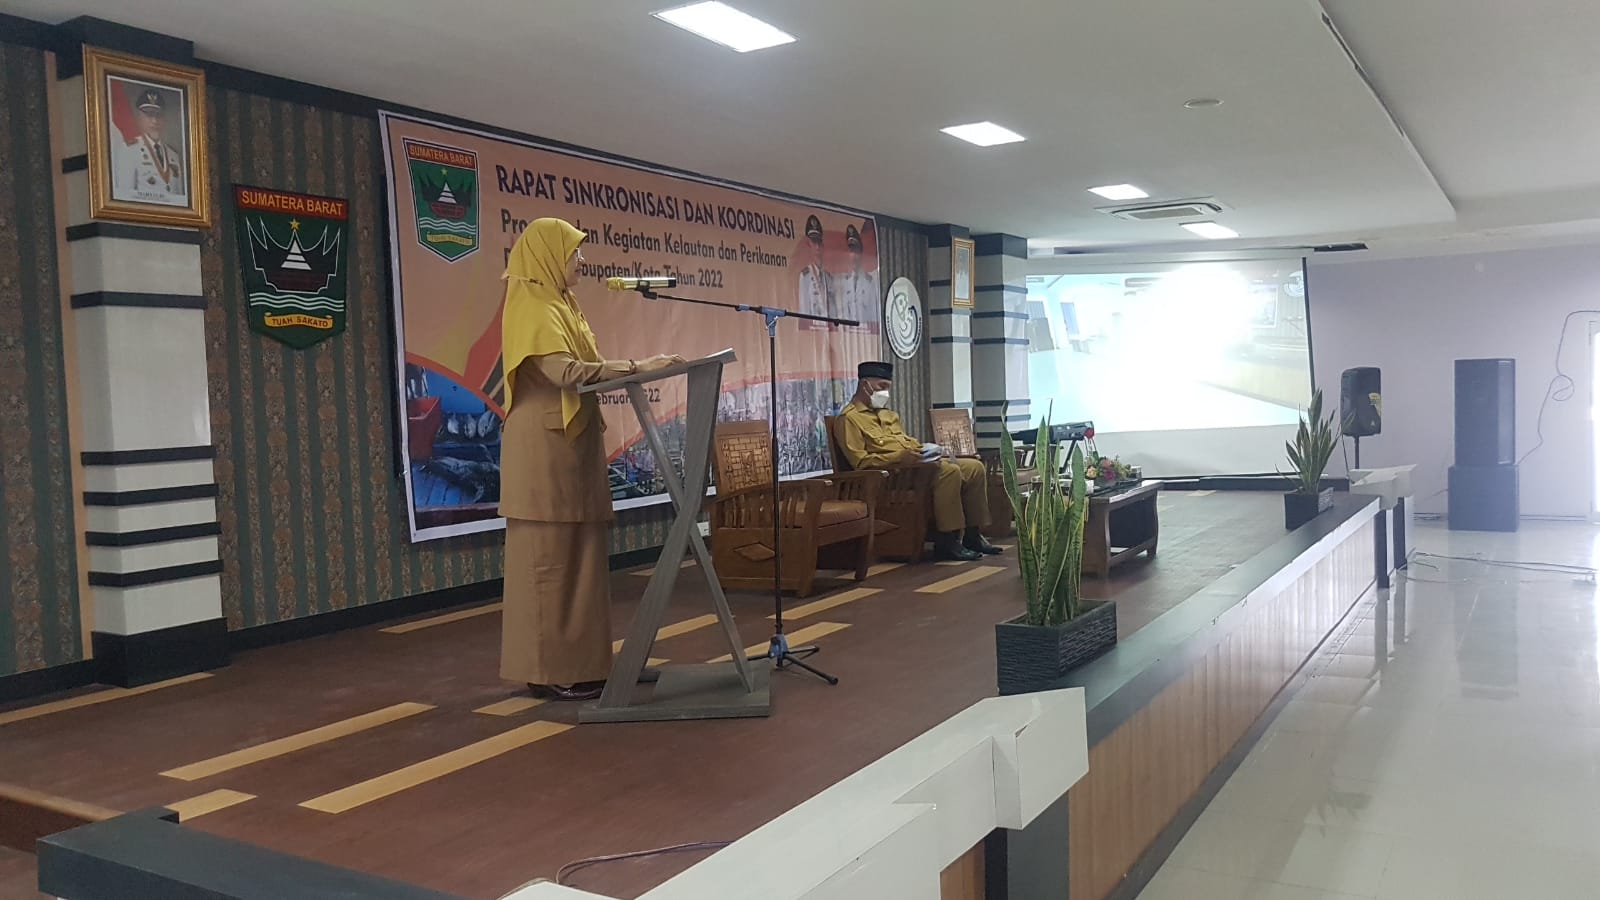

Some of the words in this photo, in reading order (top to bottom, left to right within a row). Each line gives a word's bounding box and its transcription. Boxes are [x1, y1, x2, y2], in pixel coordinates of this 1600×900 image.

[409, 144, 449, 162] SUMATERA
[449, 152, 474, 168] BARAT
[242, 190, 304, 211] SUMATERA
[306, 199, 343, 215] BARAT
[496, 165, 556, 200] RAPAT
[562, 177, 680, 221] SINKRONISASI
[684, 200, 714, 225] DAN
[717, 205, 795, 239] KOORDINASI
[603, 223, 661, 253] Kegiatan
[664, 232, 715, 258] Kelautan
[718, 240, 737, 262] dan
[740, 243, 787, 267] Perikanan
[582, 260, 661, 283] bupaten/Kota
[698, 269, 723, 288] 2022
[272, 317, 293, 326] TUAH
[296, 316, 328, 328] SAKATO
[596, 392, 630, 405] ebruar
[644, 388, 661, 403] 22
